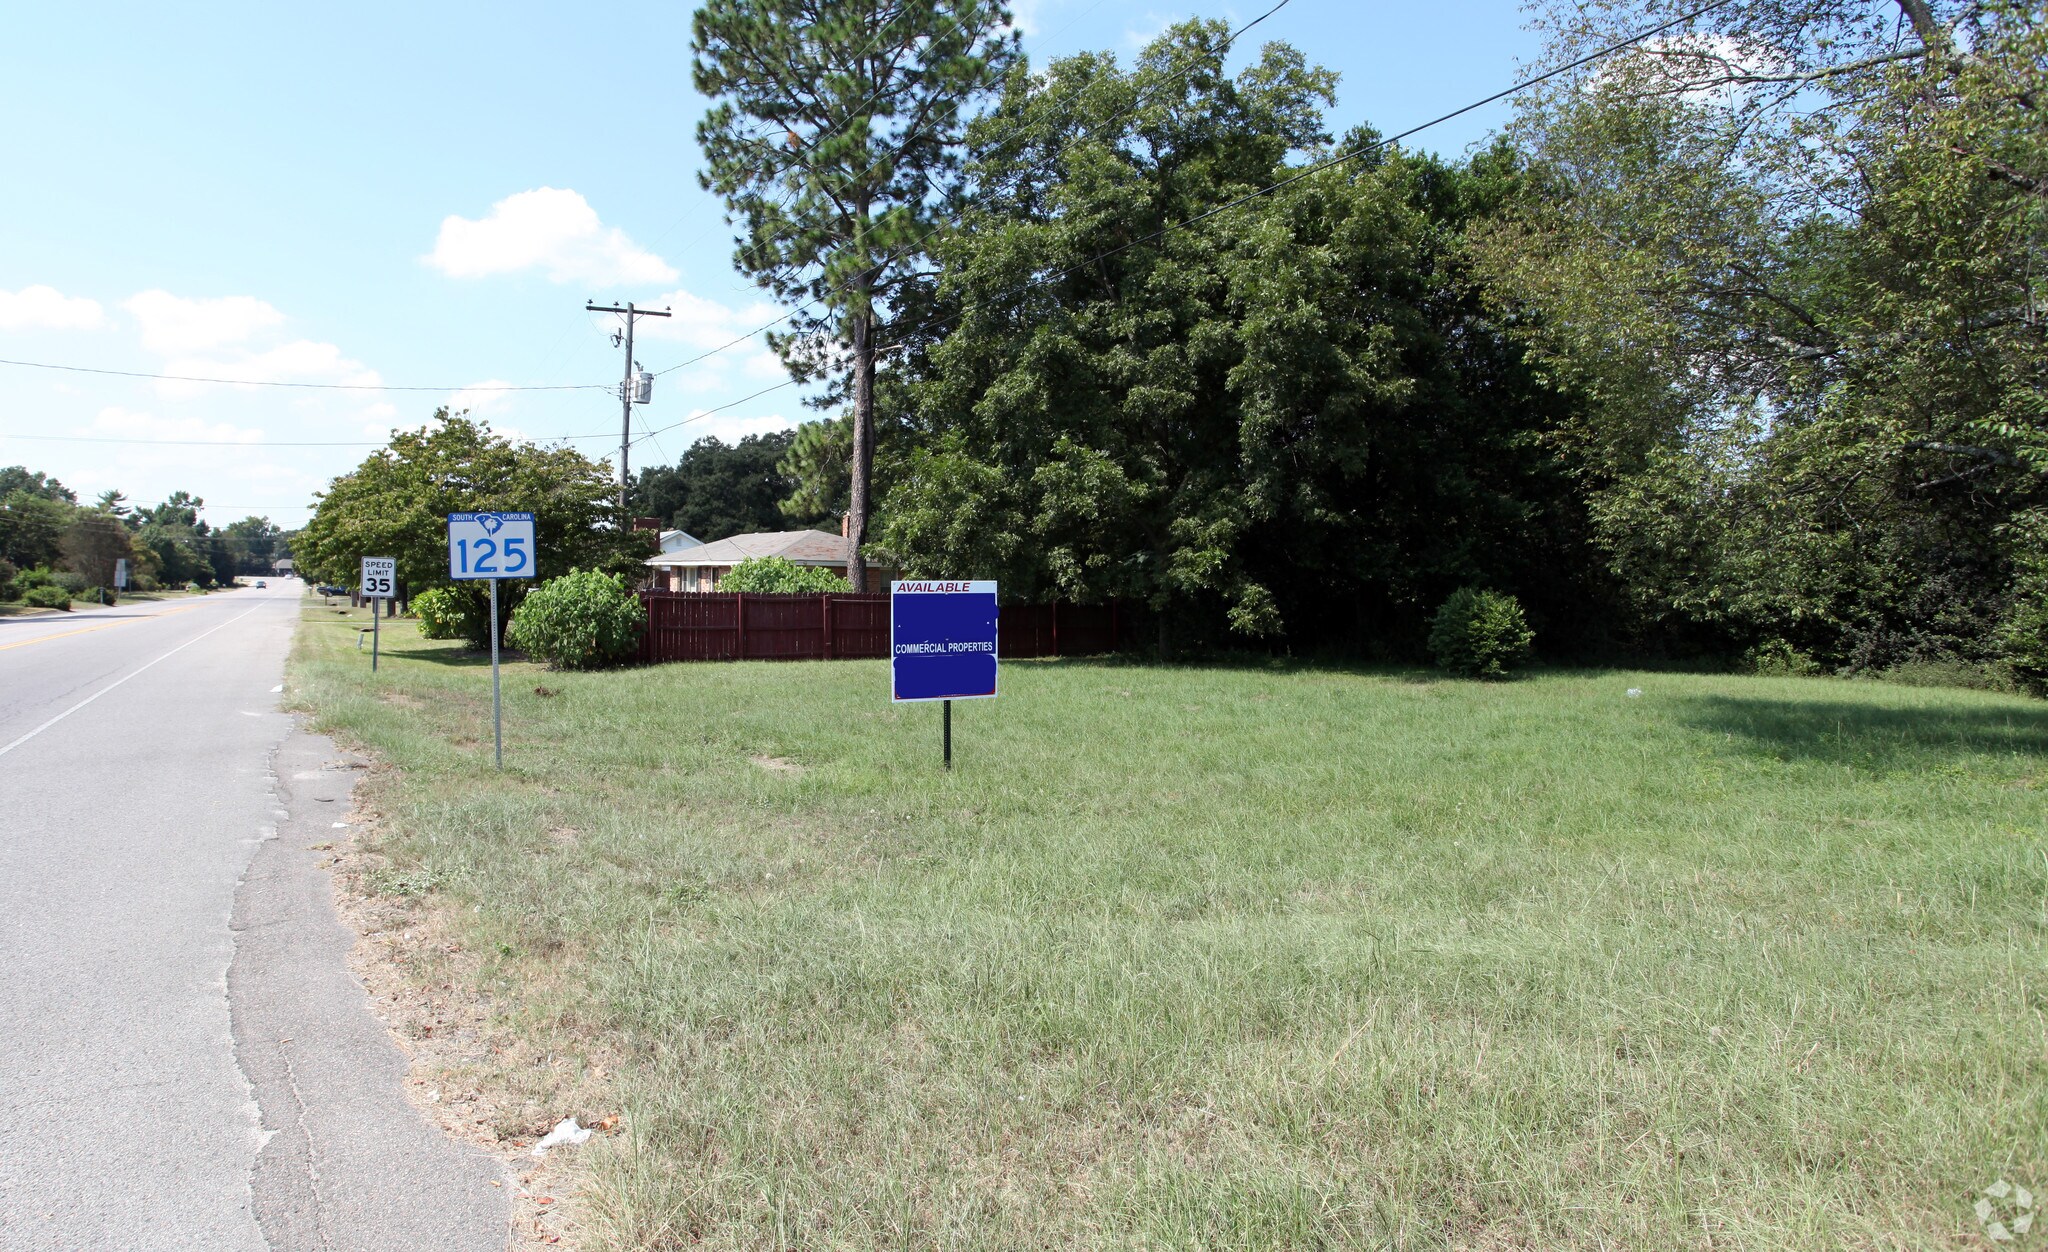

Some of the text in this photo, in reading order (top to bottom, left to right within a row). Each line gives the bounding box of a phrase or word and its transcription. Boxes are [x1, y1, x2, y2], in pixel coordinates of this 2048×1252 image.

[457, 538, 527, 573] 125
[365, 577, 391, 593] 35
[897, 582, 971, 592] AVAILABLE
[895, 641, 993, 654] COMMERCIAL PROPERTIES
